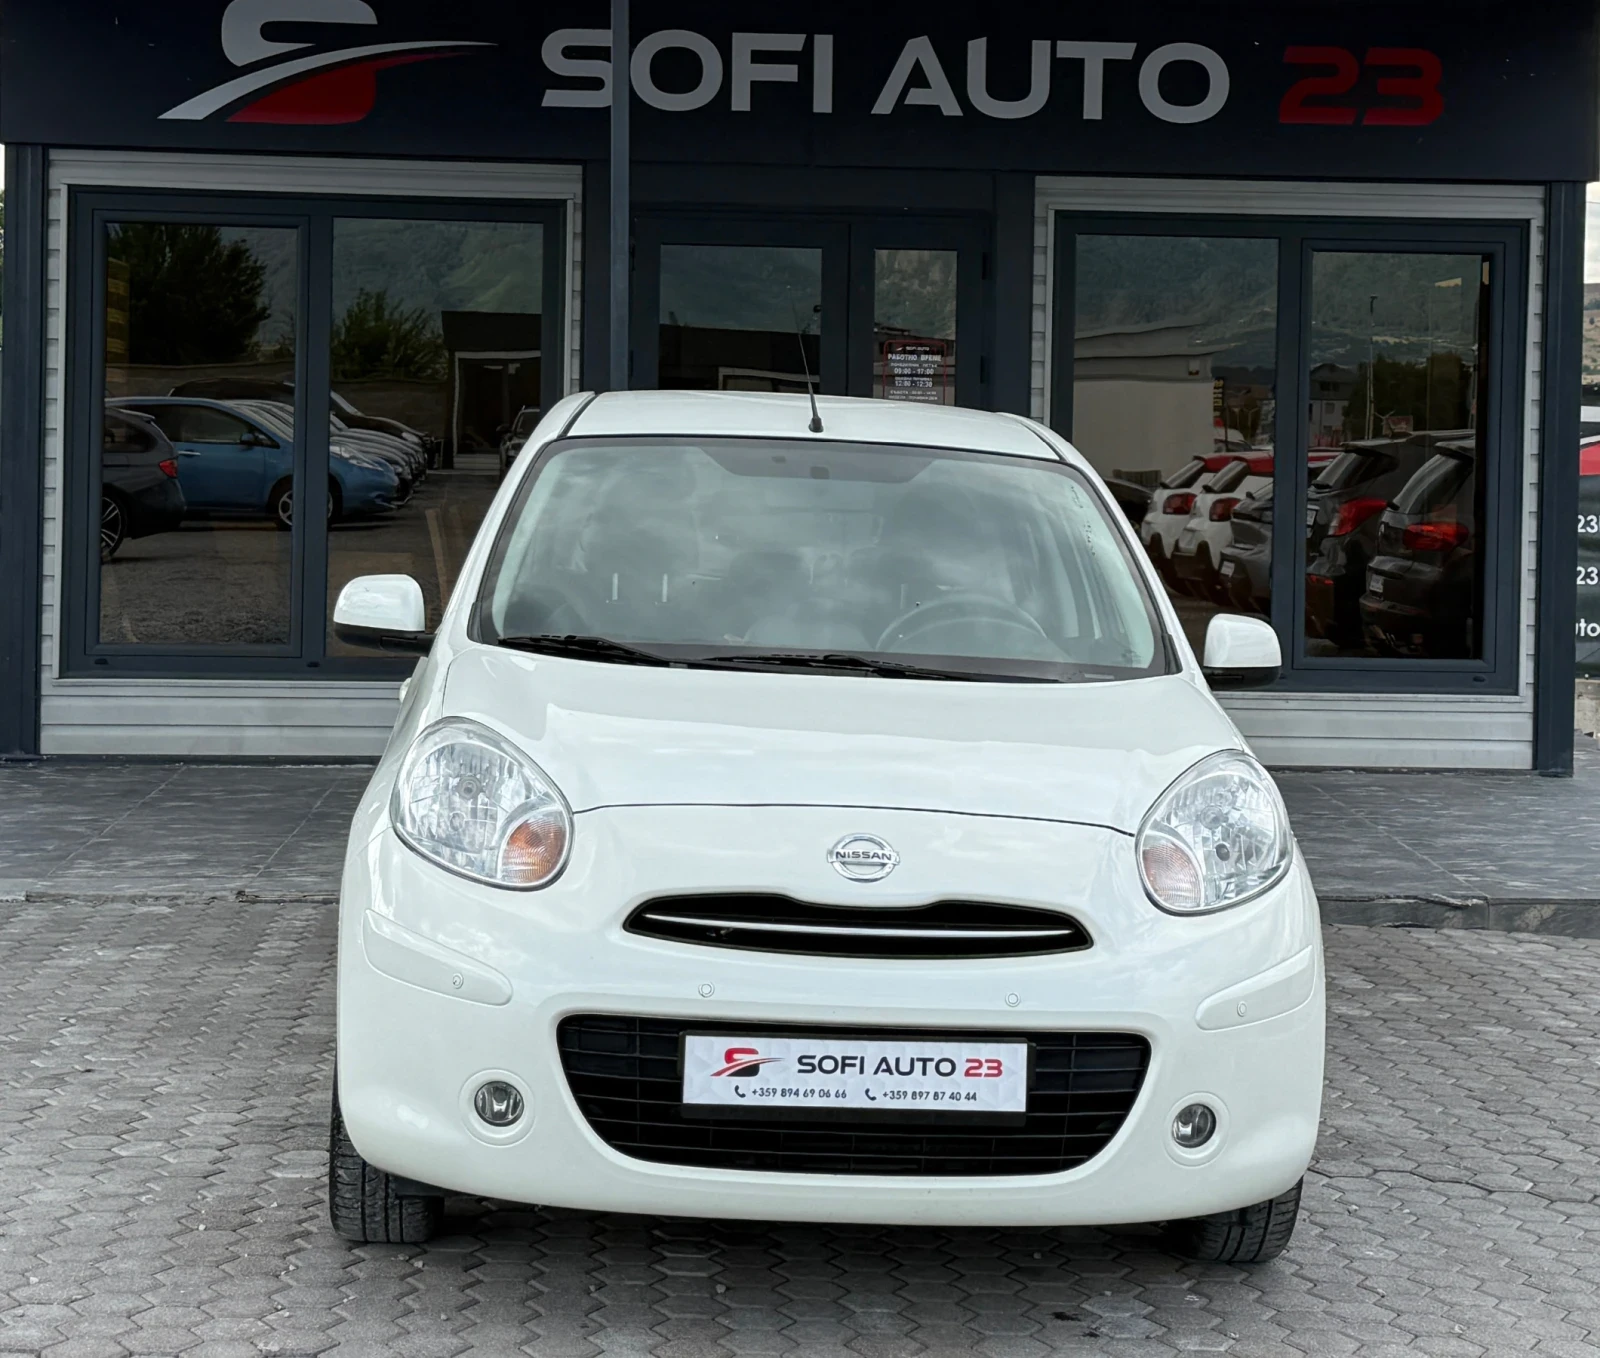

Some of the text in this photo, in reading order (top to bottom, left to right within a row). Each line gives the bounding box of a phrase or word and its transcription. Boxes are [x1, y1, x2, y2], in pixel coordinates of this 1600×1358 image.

[540, 27, 1443, 126] SOFI AUTO 23
[1577, 514, 1600, 534] 23
[835, 850, 892, 862] NISSAN
[797, 1054, 1003, 1078] SOFI AUTO 23
[752, 1087, 847, 1099] +359 894 69 06 66
[882, 1090, 977, 1102] +359 897 87 40 44
